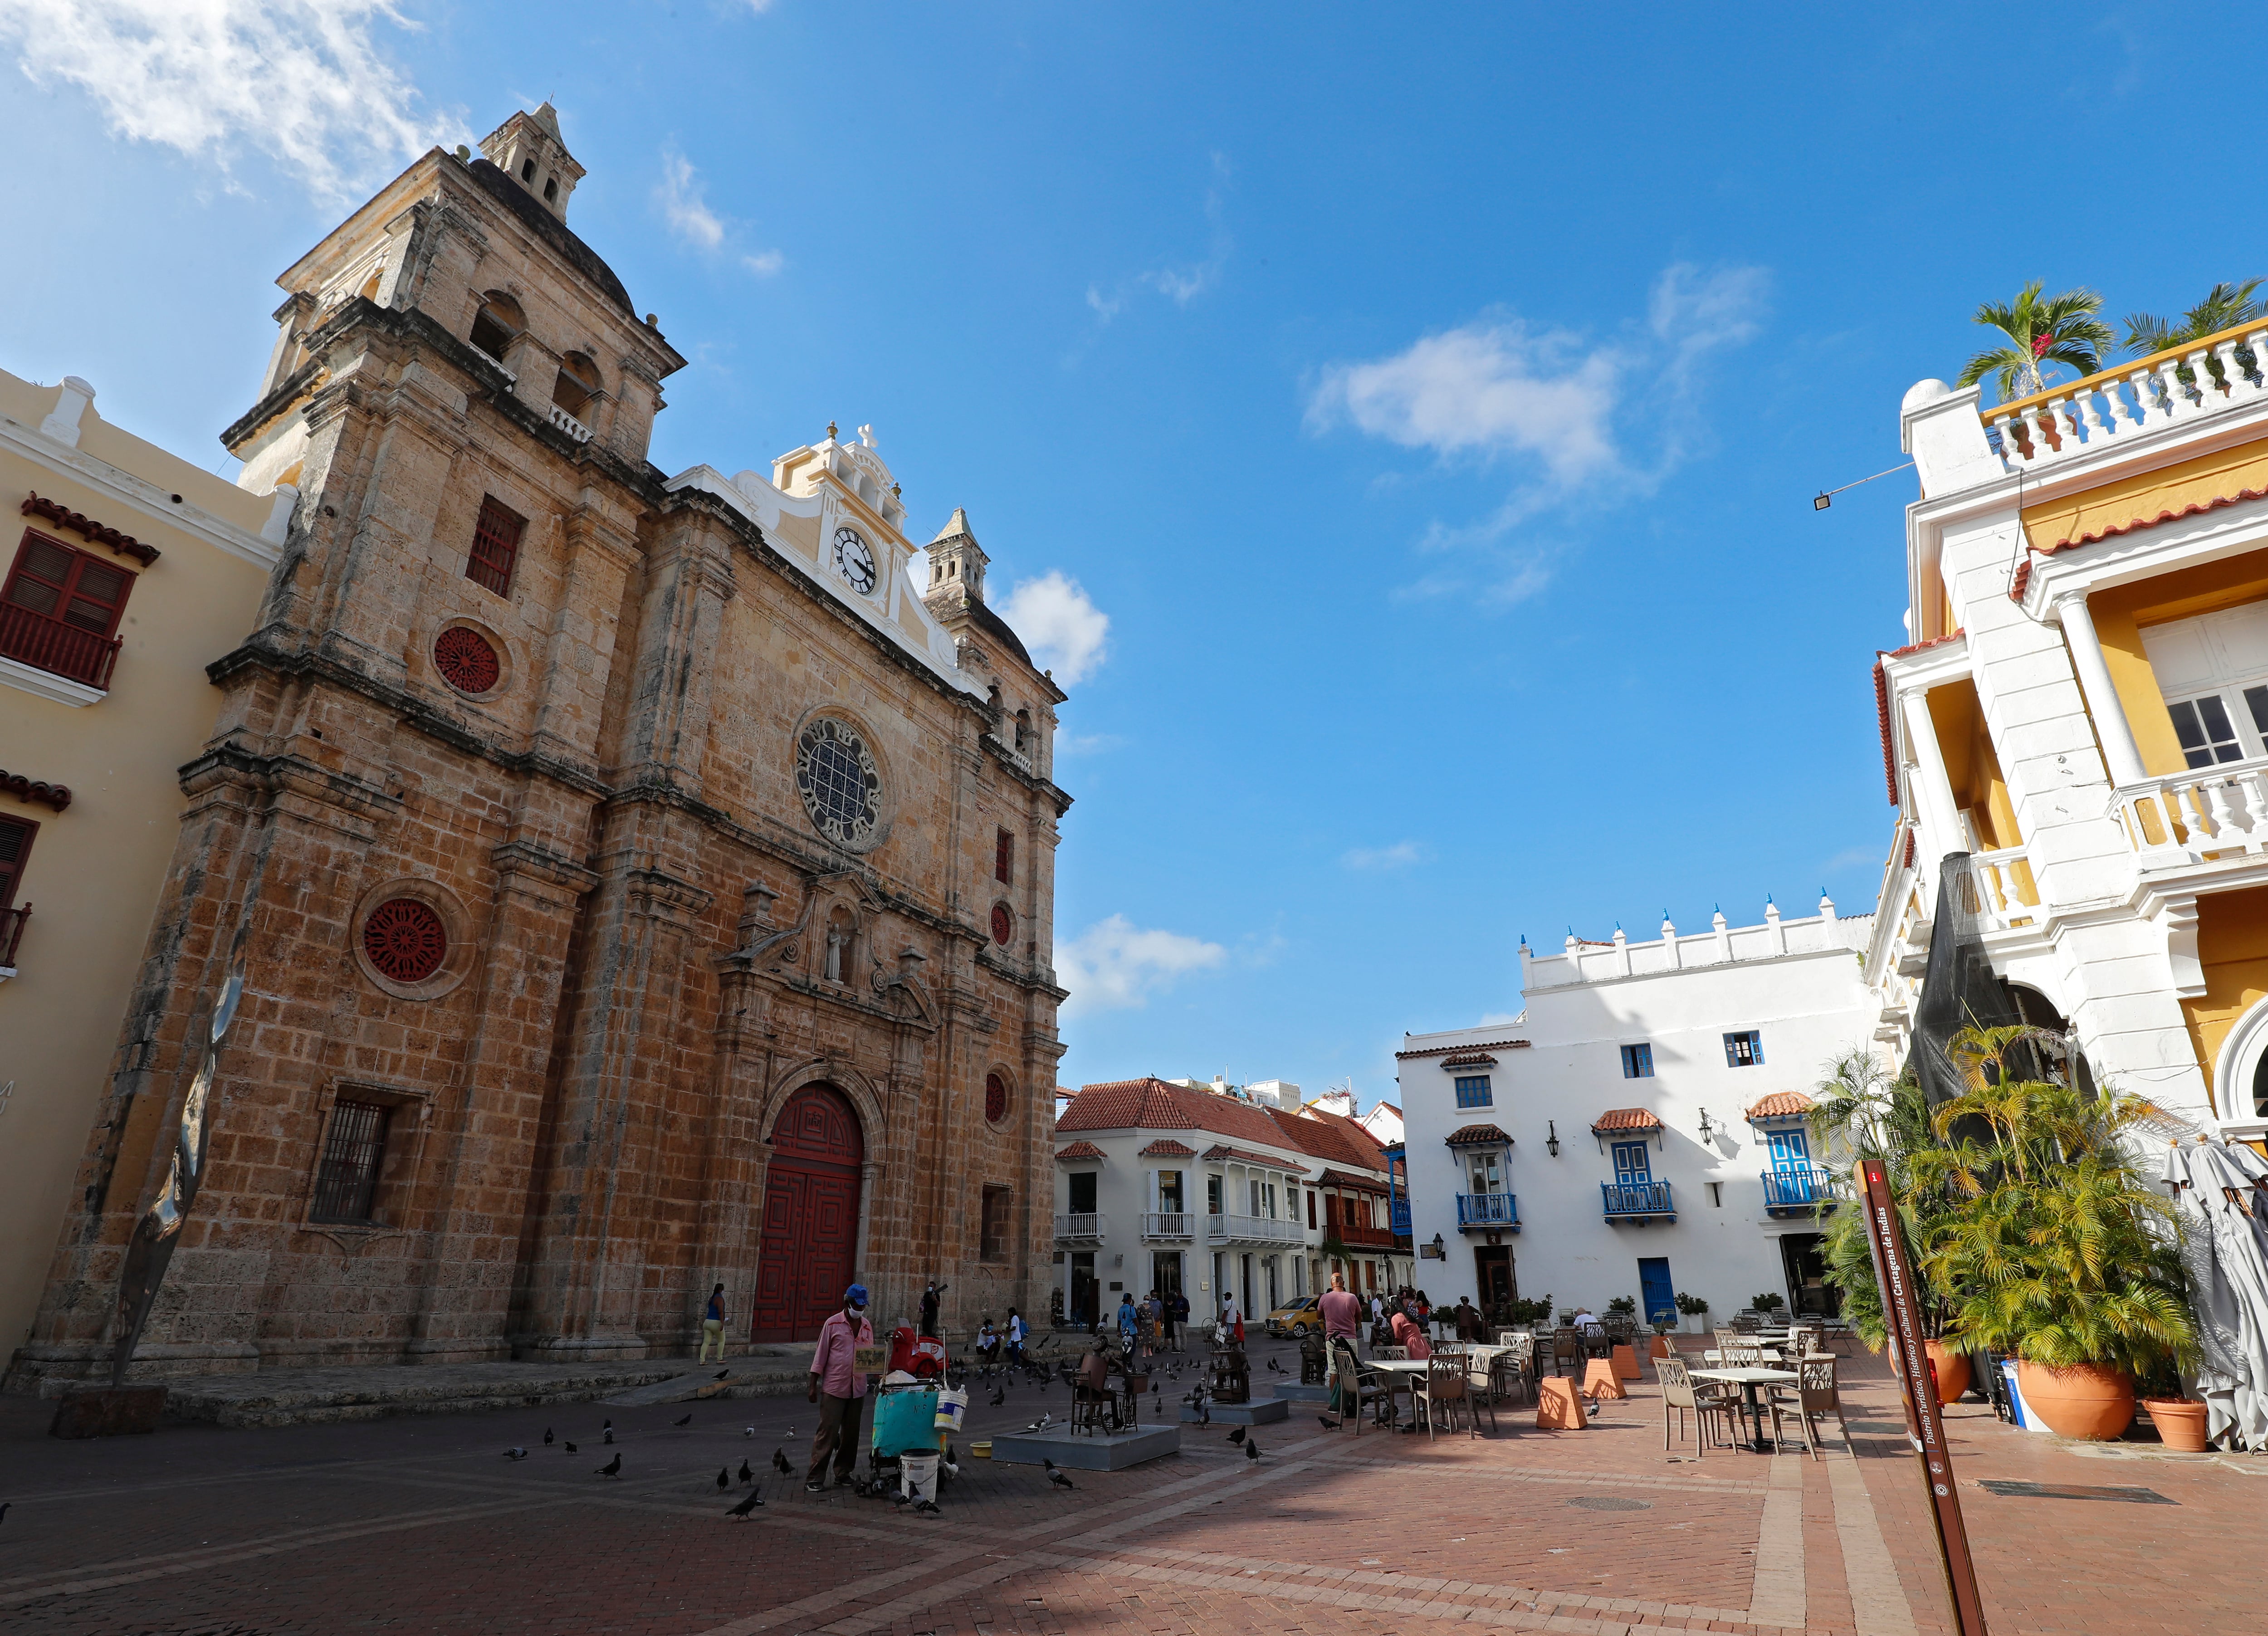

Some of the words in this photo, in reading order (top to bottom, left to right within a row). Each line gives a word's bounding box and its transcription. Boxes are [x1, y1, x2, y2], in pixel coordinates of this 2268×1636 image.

[1877, 1206, 1890, 1236] Indias
[1882, 1236, 1892, 1248] de
[1887, 1249, 1903, 1296] Cartagena
[1122, 1311, 1126, 1321] 4
[1896, 1297, 1906, 1306] de
[1897, 1307, 1912, 1338] Cultural
[1908, 1345, 1921, 1378] Histórico
[1916, 1379, 1928, 1414] Turístico,
[1922, 1415, 1935, 1445] Distrito
